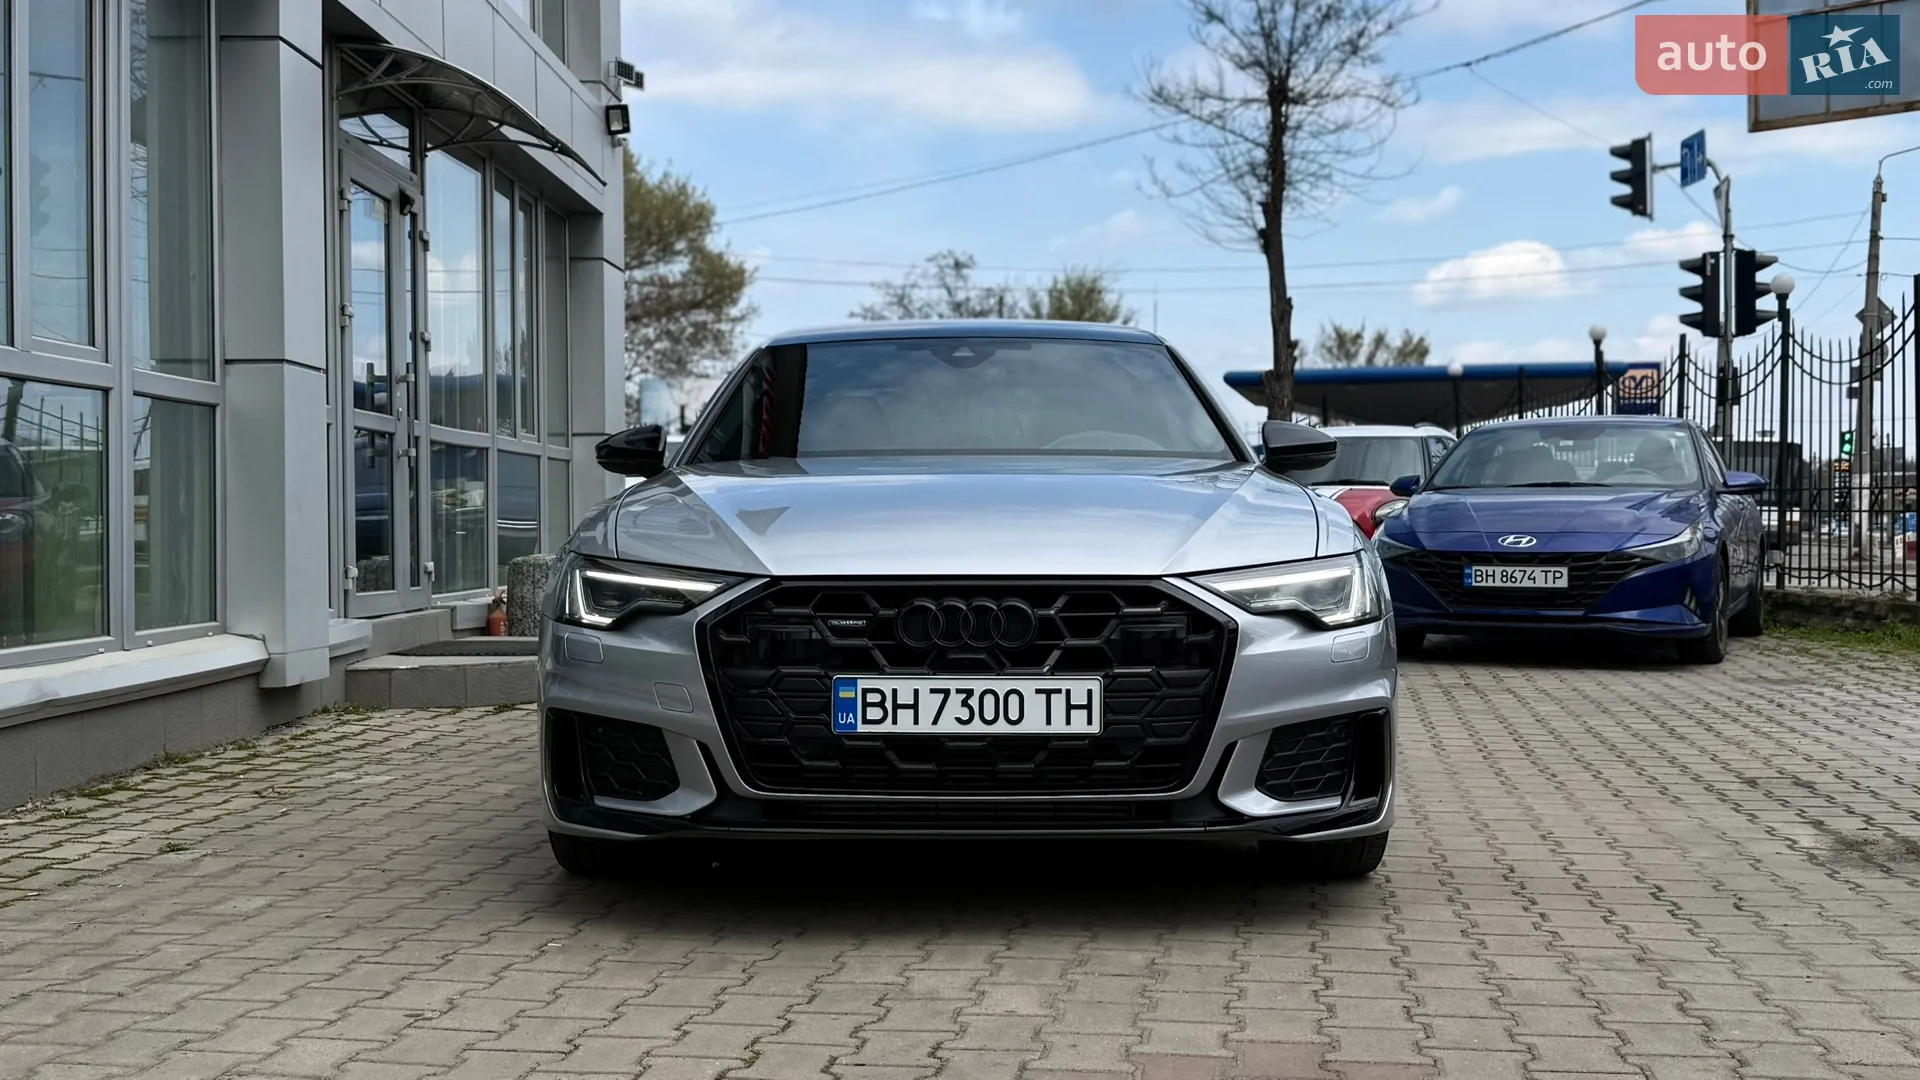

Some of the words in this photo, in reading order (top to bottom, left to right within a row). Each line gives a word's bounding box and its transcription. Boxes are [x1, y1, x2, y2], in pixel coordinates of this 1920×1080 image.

[1474, 569, 1496, 584] BH
[1500, 569, 1537, 584] 8674
[1540, 569, 1564, 585] TP
[861, 687, 920, 726] BH
[929, 687, 1025, 726] 7300
[1034, 687, 1093, 726] TH
[838, 712, 855, 724] UA
